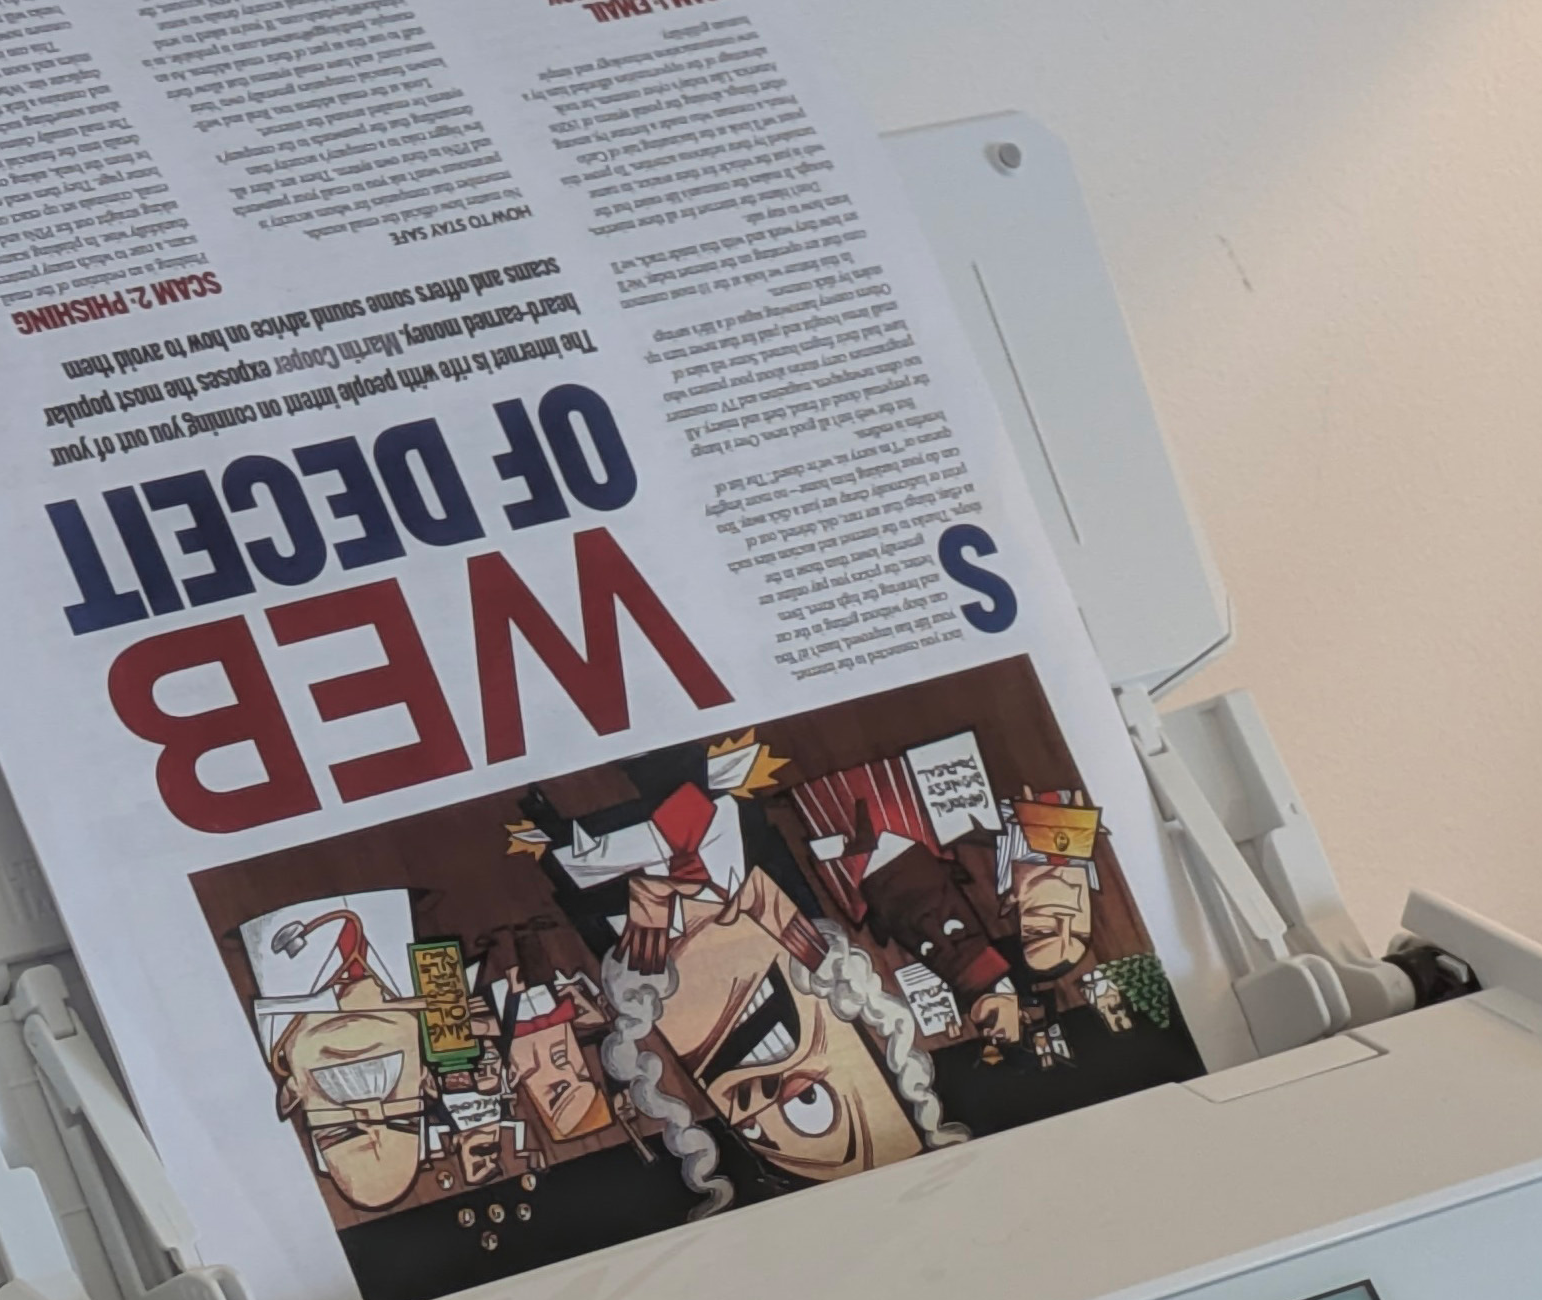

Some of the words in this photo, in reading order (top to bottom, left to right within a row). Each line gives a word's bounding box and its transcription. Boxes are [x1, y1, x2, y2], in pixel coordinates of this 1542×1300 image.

[429, 217, 468, 238] STAY
[467, 213, 495, 230] TO
[490, 204, 533, 225] HOW
[387, 225, 429, 247] SAFE
[467, 268, 505, 298] and
[502, 256, 562, 284] scams
[124, 285, 154, 310] 2:
[149, 270, 223, 307] SCAM
[364, 287, 417, 314] some
[413, 276, 471, 304] offers
[10, 290, 131, 336] PHISHING
[249, 309, 312, 341] advice
[308, 298, 367, 333] sound
[460, 291, 582, 339] heard-earned
[185, 328, 231, 354] how
[223, 323, 252, 345] on
[397, 316, 465, 347] money.
[558, 328, 599, 355] The
[111, 341, 165, 376] avoid
[162, 337, 189, 360] to
[272, 345, 341, 376] Cooper
[336, 331, 404, 365] Martin
[470, 351, 494, 376] is
[488, 335, 564, 371] internet
[60, 353, 116, 381] them
[195, 358, 273, 392] exposes
[395, 363, 441, 394] with
[437, 354, 474, 384] rife
[113, 383, 166, 414] most
[162, 375, 199, 402] the
[281, 385, 342, 417] intent
[336, 367, 400, 407] people
[42, 388, 117, 429] popular
[180, 403, 259, 439] conning
[255, 398, 284, 420] on
[114, 427, 151, 455] out
[147, 414, 187, 445] you
[49, 434, 96, 468] your
[92, 435, 117, 463] of
[491, 382, 639, 532] OF
[43, 416, 487, 637] DECEIT
[936, 522, 1019, 635] S
[106, 525, 732, 835] WEB
